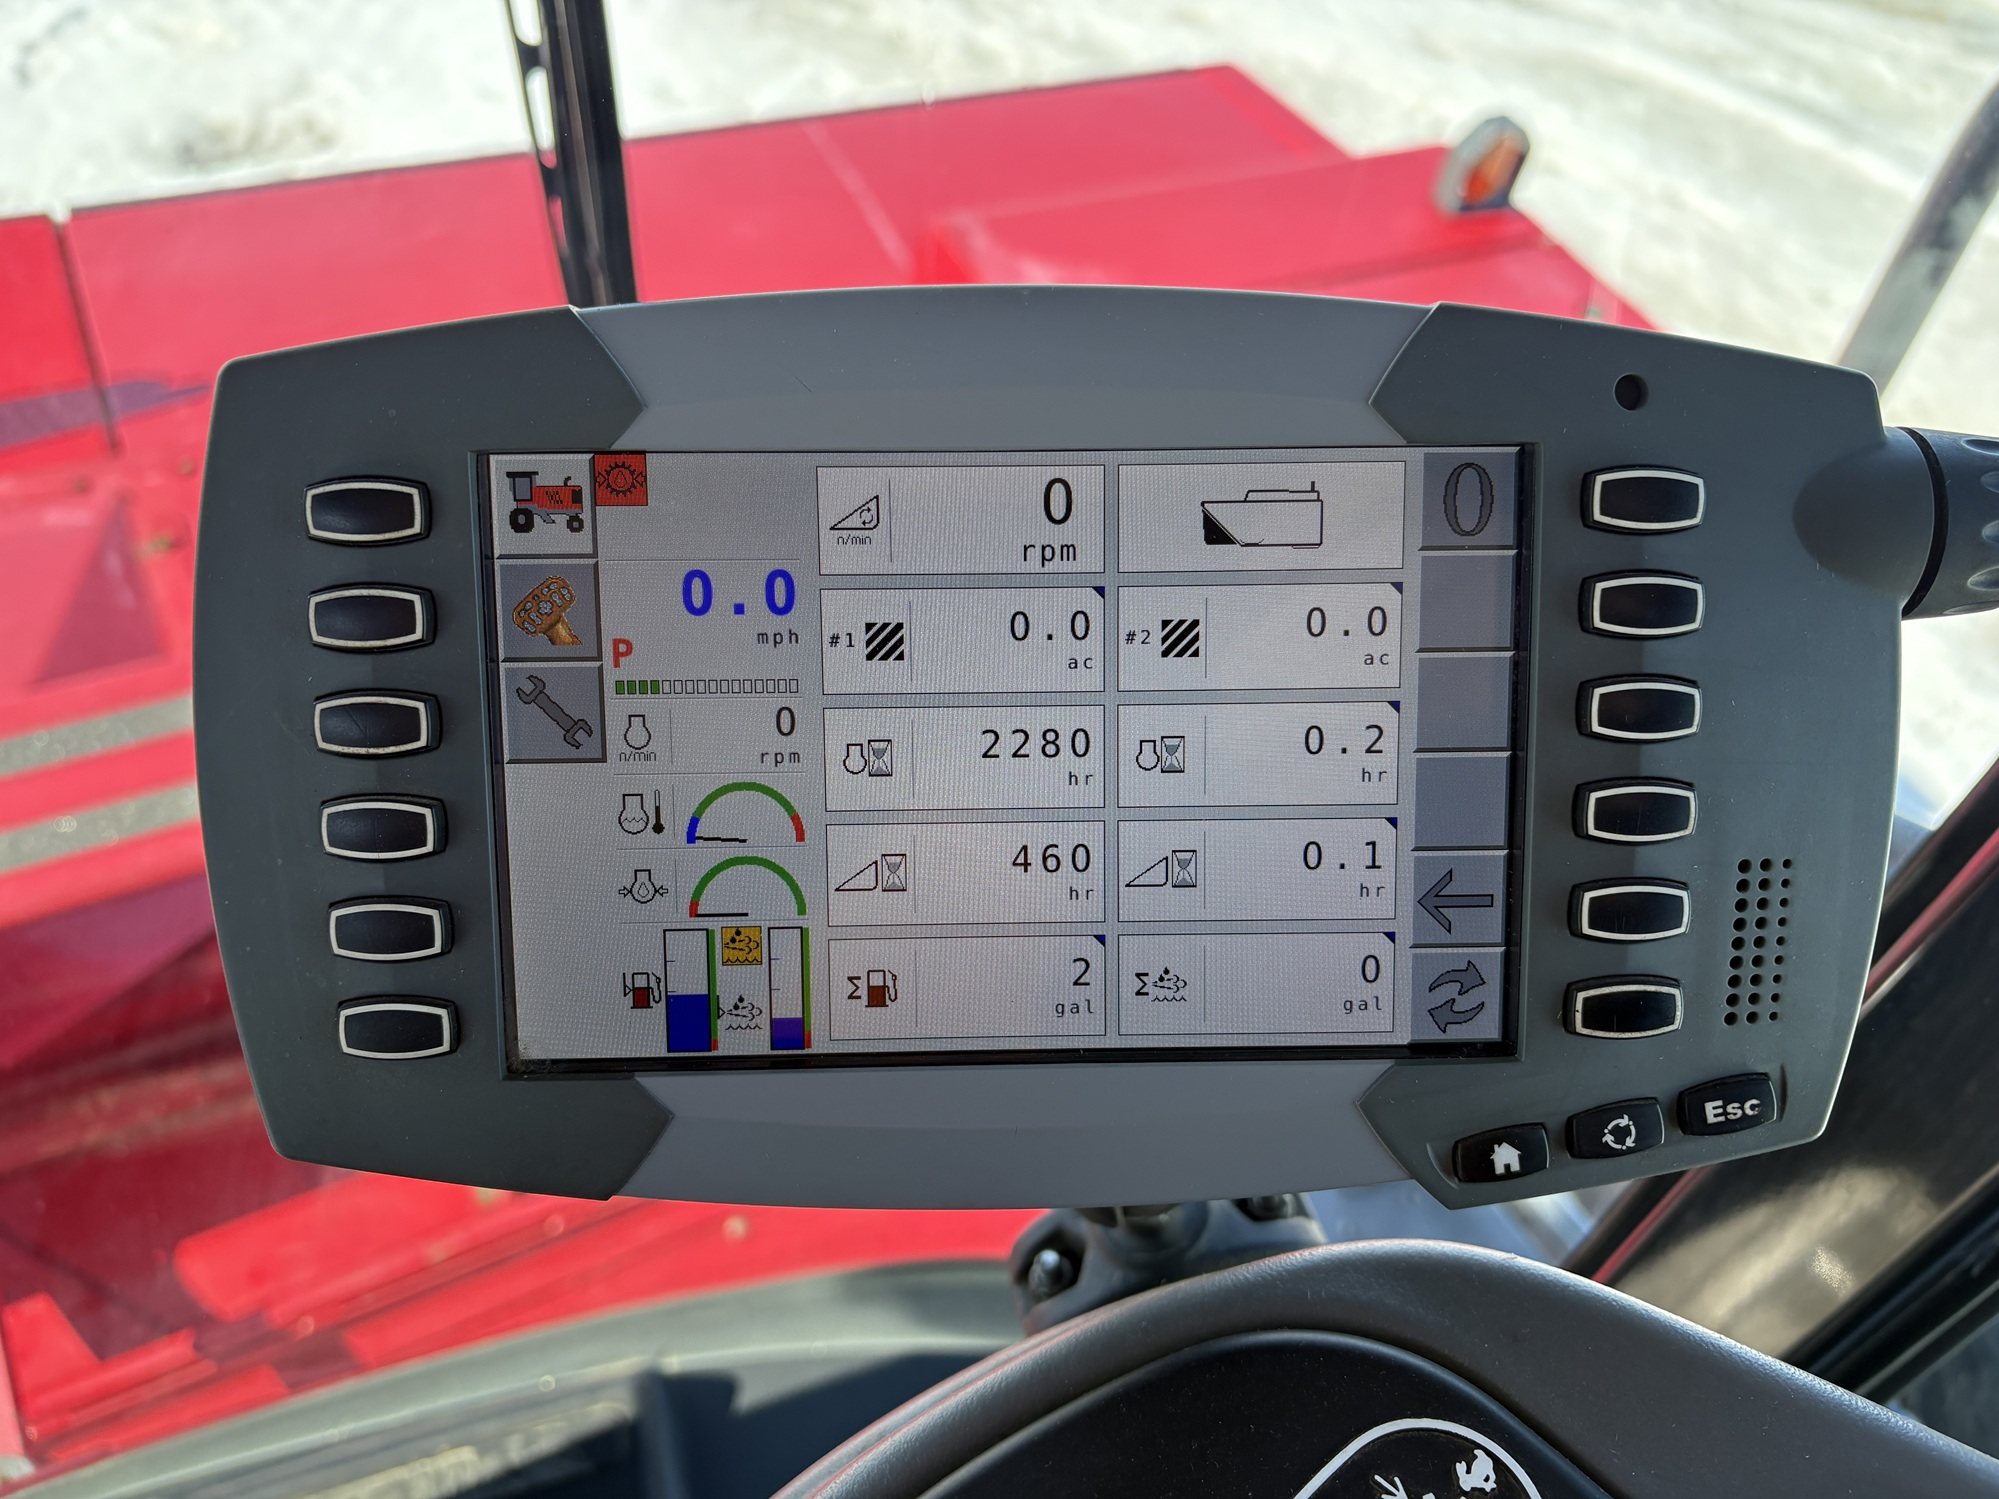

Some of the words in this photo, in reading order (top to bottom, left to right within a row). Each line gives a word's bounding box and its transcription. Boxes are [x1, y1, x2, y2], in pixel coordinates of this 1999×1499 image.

[1043, 477, 1073, 526] 0
[1442, 462, 1495, 537] 0
[837, 533, 872, 546] n/min
[1023, 543, 1077, 568] rpm
[682, 568, 796, 617] 0.0
[1010, 610, 1091, 642] 0.0
[1306, 605, 1388, 638] 0.0
[757, 628, 799, 649] mph
[828, 632, 855, 648] #1
[1124, 629, 1151, 645] #2
[612, 637, 634, 669] P
[1068, 657, 1093, 670] ac
[1363, 653, 1389, 666] ac
[775, 706, 796, 737] 0
[981, 727, 1091, 759] 2280
[1304, 724, 1384, 755] 0.2
[619, 748, 657, 762] n/min
[760, 751, 801, 768] rpm
[1068, 770, 1094, 786] hr
[1361, 767, 1388, 783] hr
[1011, 843, 1091, 874] 460
[1302, 840, 1382, 871] 0.1
[1069, 885, 1094, 901] hr
[1359, 882, 1386, 898] hr
[1072, 957, 1091, 987] 2
[1361, 954, 1381, 984] 0
[1055, 998, 1094, 1018] gal
[1343, 995, 1382, 1015] gal
[1704, 1098, 1761, 1124] Esc
